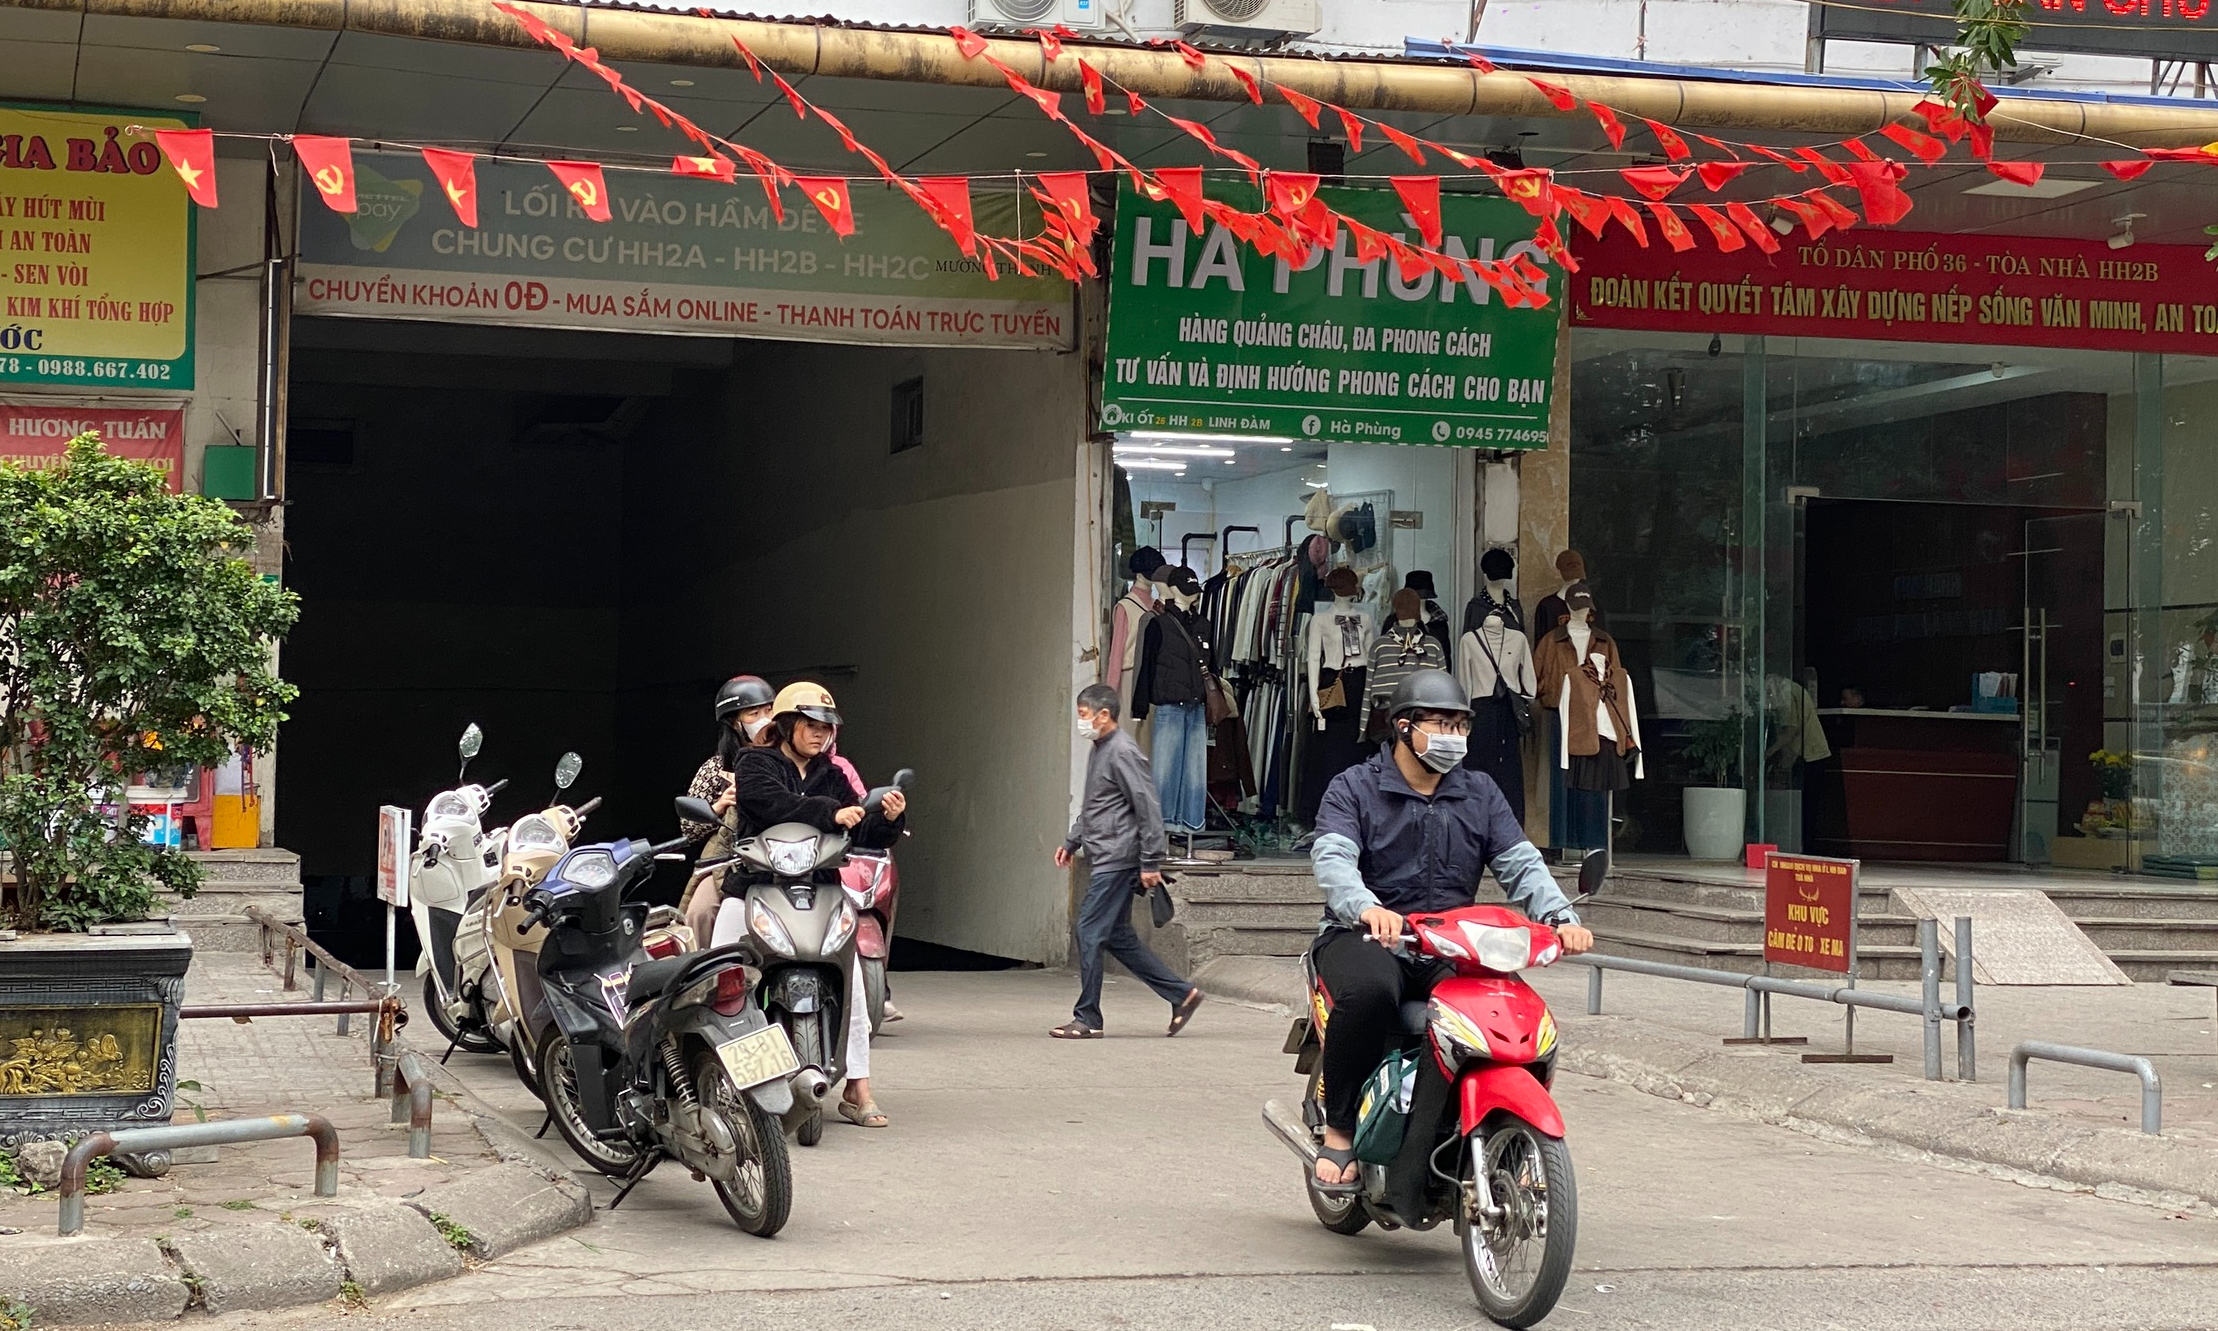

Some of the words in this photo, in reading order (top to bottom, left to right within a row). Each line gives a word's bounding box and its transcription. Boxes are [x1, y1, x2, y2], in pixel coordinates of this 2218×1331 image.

[65, 125, 161, 175] BẢO
[23, 194, 62, 219] HÚT
[68, 196, 105, 222] MÙI
[357, 202, 402, 222] pay
[504, 184, 557, 219] LỐI
[565, 194, 592, 219] R
[618, 193, 687, 227] VÀO
[695, 196, 768, 231] HẦM
[10, 230, 35, 251] AN
[42, 228, 91, 254] TOÀN
[432, 229, 555, 260] CHUNG
[563, 236, 613, 263] CƯ
[617, 240, 707, 269] HH2A
[734, 247, 817, 275] HH2B
[843, 254, 930, 281] HH2C
[1798, 236, 1829, 267] TỔ
[1835, 244, 1884, 270] DÂN
[1892, 241, 1939, 272] PHỐ
[1943, 254, 1967, 273] 36
[1986, 250, 2031, 276] TÒA
[2039, 253, 2090, 279] NHÀ
[2099, 260, 2159, 282] HH2B
[14, 263, 49, 285] SEN
[56, 261, 88, 287] VÒI
[997, 262, 1052, 276] THNH
[7, 296, 41, 318] KIM
[48, 294, 80, 319] KHÍ
[86, 292, 132, 323] TỔNG
[138, 300, 174, 327] HỢP
[308, 274, 406, 304] CHUYỂN
[412, 282, 498, 309] KHOẢN
[566, 292, 618, 316] MUA
[622, 288, 672, 318] SẮM
[677, 299, 759, 323] ONLINE
[777, 303, 855, 329] THANH
[860, 305, 921, 331] TOÁN
[929, 311, 984, 337] TRỰC
[990, 309, 1061, 336] TUYẾN
[1590, 273, 1648, 309] ĐOÀN
[1653, 270, 1693, 311] KẾT
[1699, 273, 1764, 315] QUYẾT
[1770, 280, 1815, 316] TÂM
[1821, 283, 1861, 319] XÂY
[1868, 288, 1926, 327] DỰNG
[1931, 283, 1973, 324] NẾP
[1979, 285, 2034, 327] SỐNG
[2040, 293, 2081, 328] VĂN
[2089, 300, 2147, 335] MINH,
[2154, 303, 2184, 333] AN
[2192, 305, 2218, 334] TO
[1179, 312, 1228, 344] HÀNG
[1233, 313, 1293, 348] QUẢNG
[1298, 318, 1348, 352] CHÂU,
[1352, 328, 1377, 352] ĐA
[1381, 329, 1441, 356] PHONG
[1445, 326, 1492, 358] CÁCH
[37, 359, 171, 380] 0988.667.402
[1115, 357, 1140, 384] TƯ
[1146, 351, 1182, 387] VẤN
[1187, 358, 1210, 387] VÀ
[1216, 364, 1260, 394] ĐỊNH
[1267, 360, 1330, 394] HƯỚNG
[1338, 371, 1400, 397] PHONG
[1407, 367, 1455, 400] CÁCH
[1463, 375, 1500, 402] CHO
[1506, 379, 1546, 409] BẠN
[103, 416, 166, 440] TUẤN
[1122, 415, 1134, 424] KI
[1137, 408, 1155, 425] ỐT
[1169, 415, 1188, 426] HH
[1208, 416, 1237, 429] LINH
[1240, 415, 1271, 431] ĐÀM
[1330, 419, 1351, 434] Hà
[1355, 420, 1402, 440] Phùng
[1456, 426, 1494, 440] 0945
[1497, 428, 1547, 443] 774695
[1788, 903, 1808, 922] KHU
[1809, 905, 1829, 928] VỰC
[1819, 937, 1831, 955] XE
